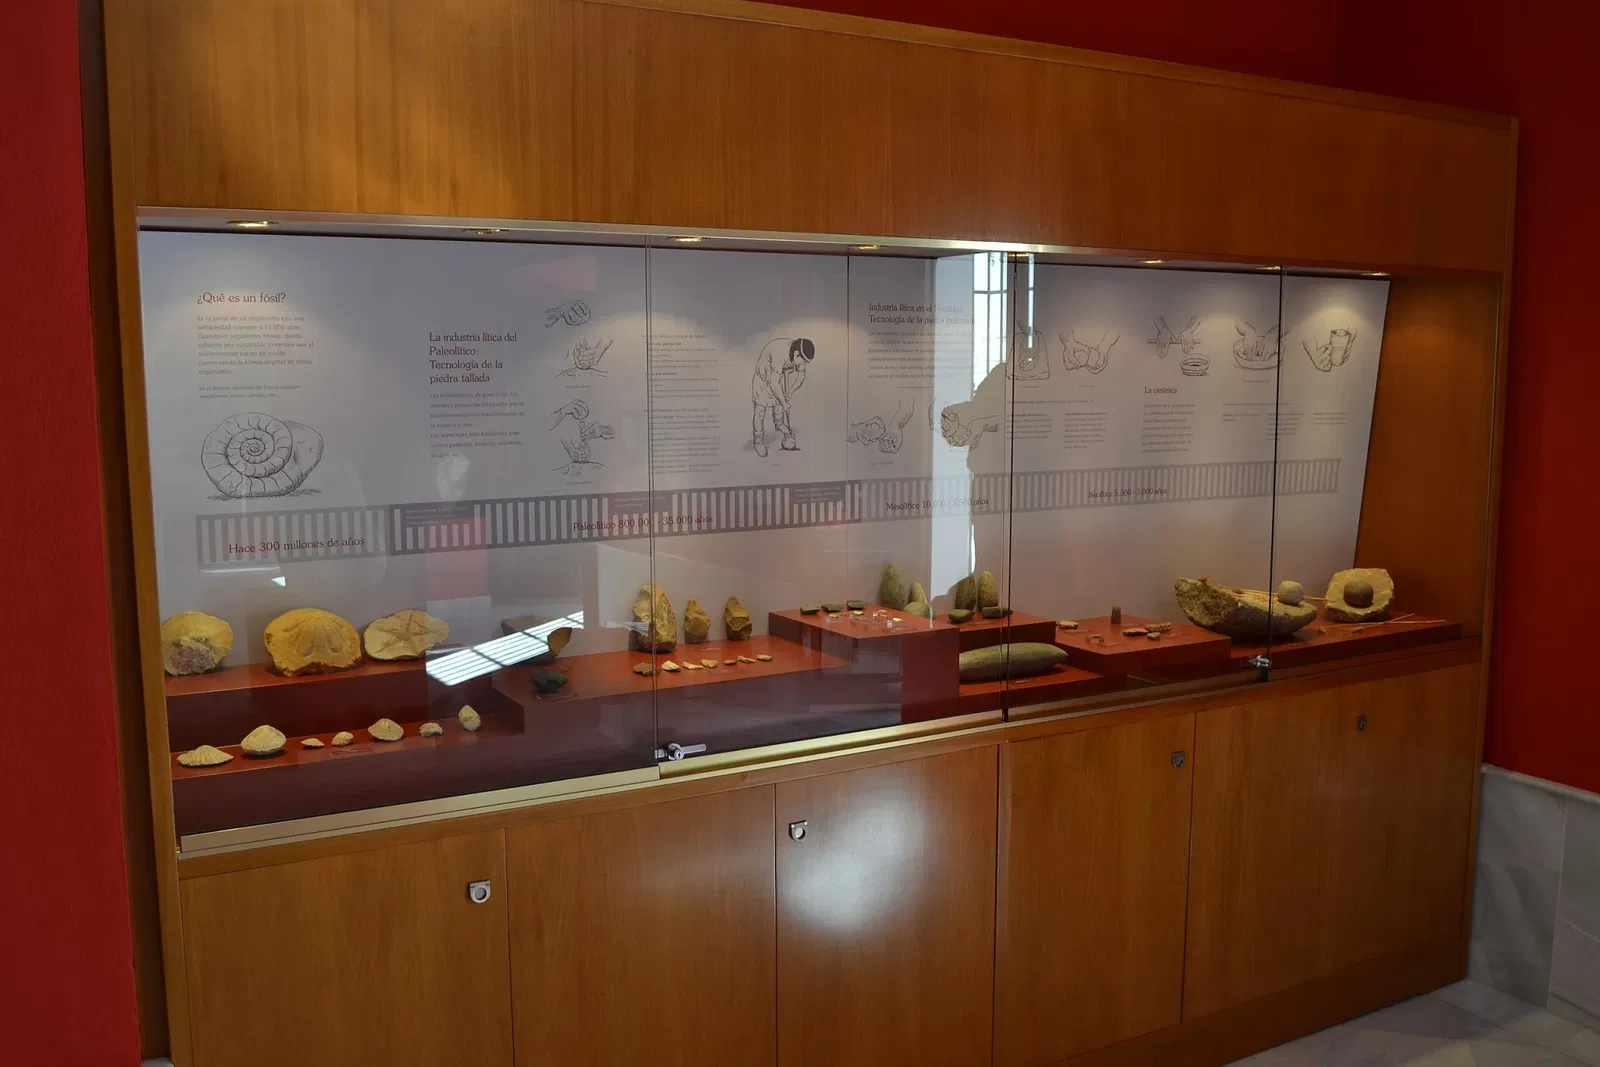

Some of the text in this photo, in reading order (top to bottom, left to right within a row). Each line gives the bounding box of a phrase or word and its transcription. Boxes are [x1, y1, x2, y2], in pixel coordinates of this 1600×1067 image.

[197, 292, 225, 304] ¿Qué
[260, 292, 286, 302] fósil?
[868, 302, 898, 312] Industria
[900, 304, 914, 312] lítica
[926, 304, 932, 312] el
[868, 314, 905, 324] Tecnología
[429, 332, 517, 342] La industria lítica del
[429, 346, 479, 356] Paleolítico:
[429, 360, 503, 371] Tecnología de la
[430, 373, 490, 385] piedra tallada
[1144, 386, 1178, 394] La cerámica
[886, 502, 919, 510] Mesolítico
[974, 498, 988, 506] años
[573, 522, 615, 532] Paleolítico
[618, 518, 653, 528] 800.00
[662, 516, 692, 525] 35.000
[695, 515, 713, 524] años
[228, 537, 365, 554] Hace 300 millones de años
